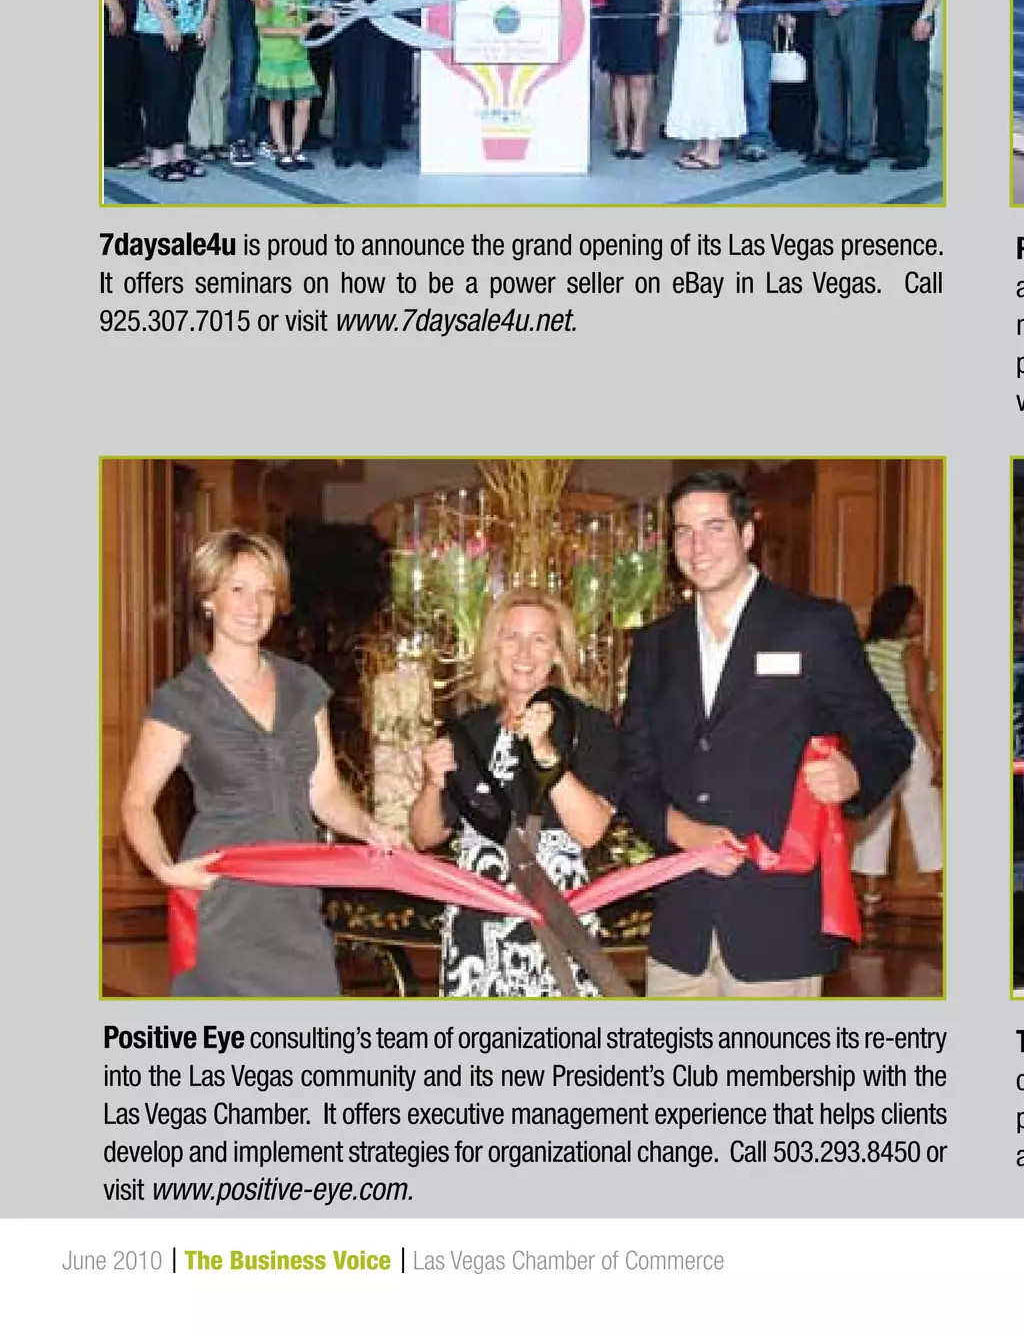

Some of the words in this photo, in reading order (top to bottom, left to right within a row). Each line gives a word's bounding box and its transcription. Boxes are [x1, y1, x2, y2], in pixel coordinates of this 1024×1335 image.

[99, 231, 236, 262] 7daysale4u
[243, 233, 261, 257] is
[267, 233, 328, 261] proud
[333, 233, 355, 257] to
[361, 237, 465, 257] announce
[470, 233, 505, 257] the
[511, 233, 572, 262] grand
[579, 233, 663, 262] opening
[670, 232, 692, 257] of
[697, 233, 722, 257] its
[728, 233, 766, 257] Las
[769, 233, 835, 262] Vegas
[841, 237, 944, 261] presence.
[99, 309, 251, 333] 925.307.7015
[257, 313, 280, 333] or
[284, 309, 329, 333] visit
[336, 307, 577, 338] www.7daysale4u.net.
[103, 1024, 198, 1050] Positive
[203, 1025, 245, 1055] Eye
[249, 1026, 372, 1055] consulting’s
[375, 1026, 429, 1050] team
[433, 1026, 455, 1050] of
[457, 1026, 602, 1055] organizational
[606, 1026, 714, 1055] strategists
[718, 1031, 831, 1050] announces
[836, 1026, 860, 1050] its
[864, 1026, 948, 1054] re-entry
[103, 1139, 184, 1168] develop
[188, 1139, 228, 1163] and
[233, 1139, 344, 1168] implement
[348, 1139, 450, 1168] strategies
[453, 1139, 484, 1163] for
[487, 1139, 632, 1168] organizational
[637, 1139, 719, 1168] change.
[729, 1139, 767, 1163] Call
[773, 1140, 921, 1163] 503.293.8450
[926, 1144, 949, 1163] or
[102, 1177, 145, 1201] visit
[153, 1176, 413, 1207] www.positive-eye.com.
[61, 1250, 107, 1271] June
[113, 1250, 162, 1271] 2010
[184, 1250, 223, 1271] The
[230, 1249, 327, 1271] Business
[332, 1250, 392, 1271] Voice
[413, 1250, 446, 1271] Las
[450, 1250, 506, 1275] Vegas
[512, 1249, 596, 1271] Chamber
[601, 1250, 619, 1271] of
[625, 1249, 724, 1271] Commerce
